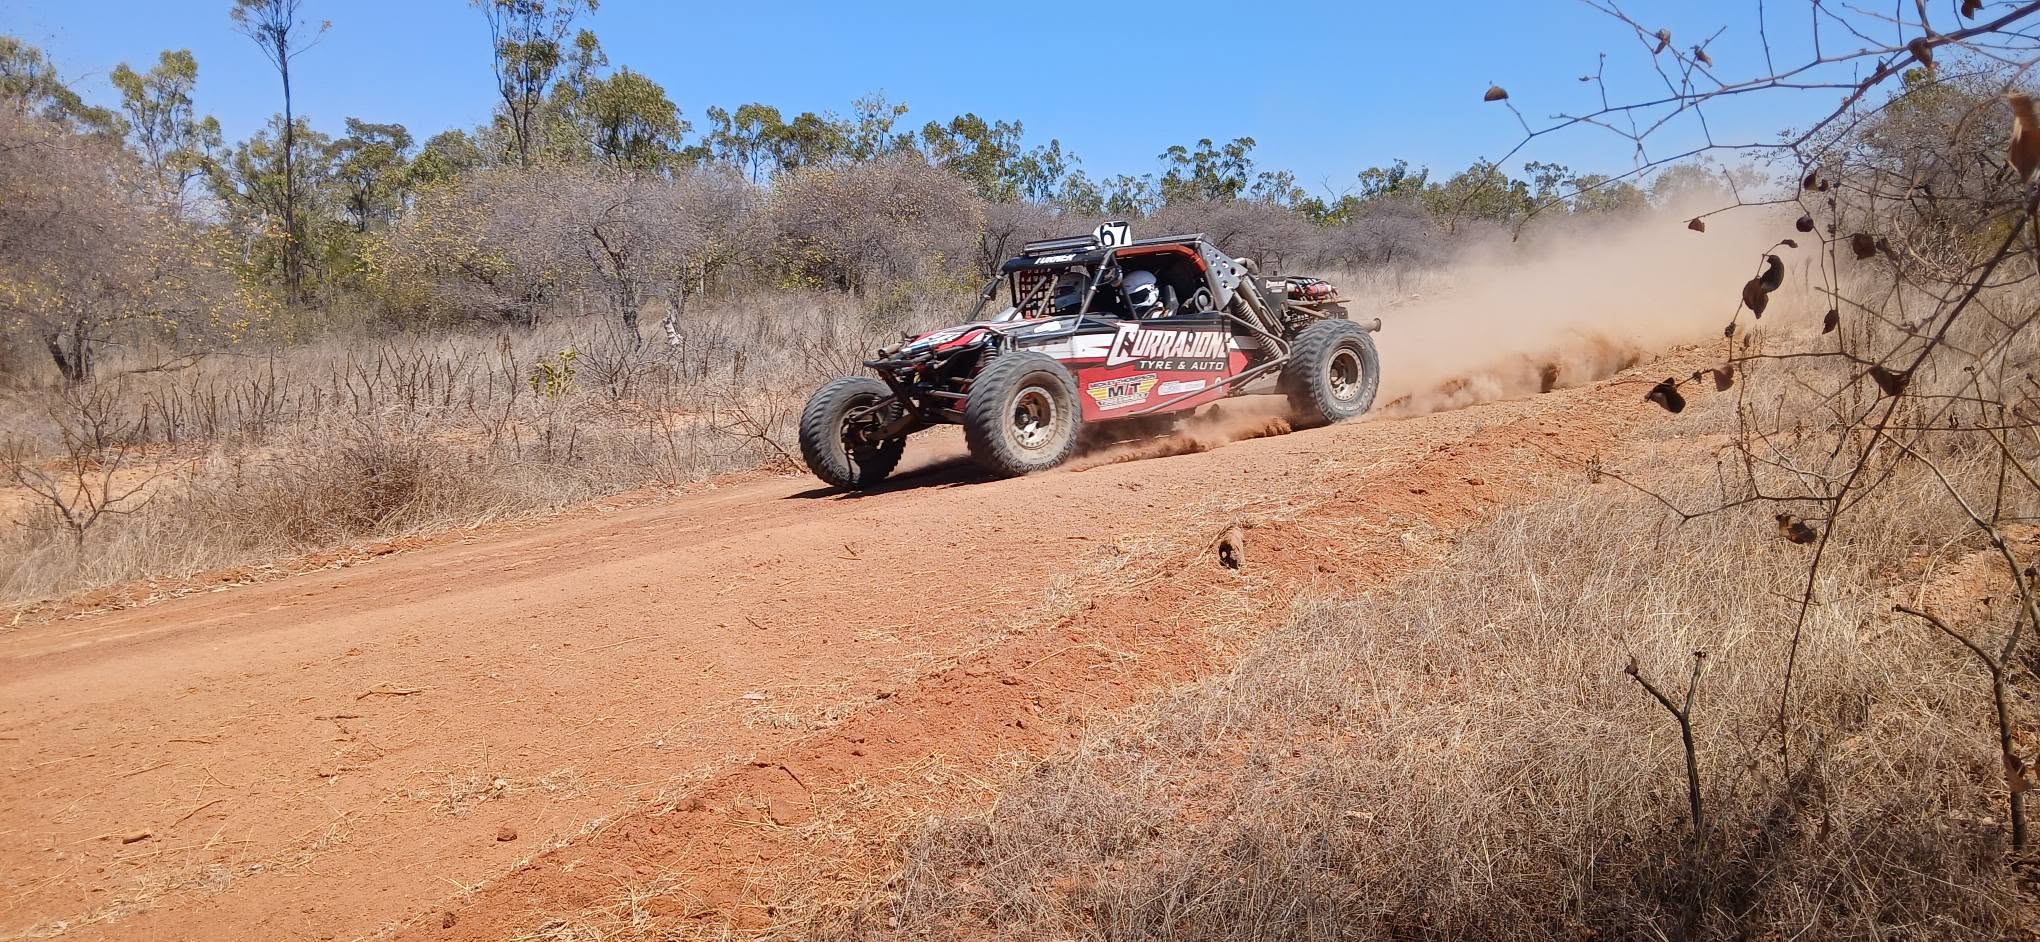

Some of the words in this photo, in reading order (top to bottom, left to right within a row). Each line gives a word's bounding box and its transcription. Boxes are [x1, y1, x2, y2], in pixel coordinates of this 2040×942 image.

[1099, 222, 1130, 247] 67
[1140, 360, 1173, 370] TYRE
[1177, 361, 1186, 370] &
[1191, 361, 1225, 370] AUTO
